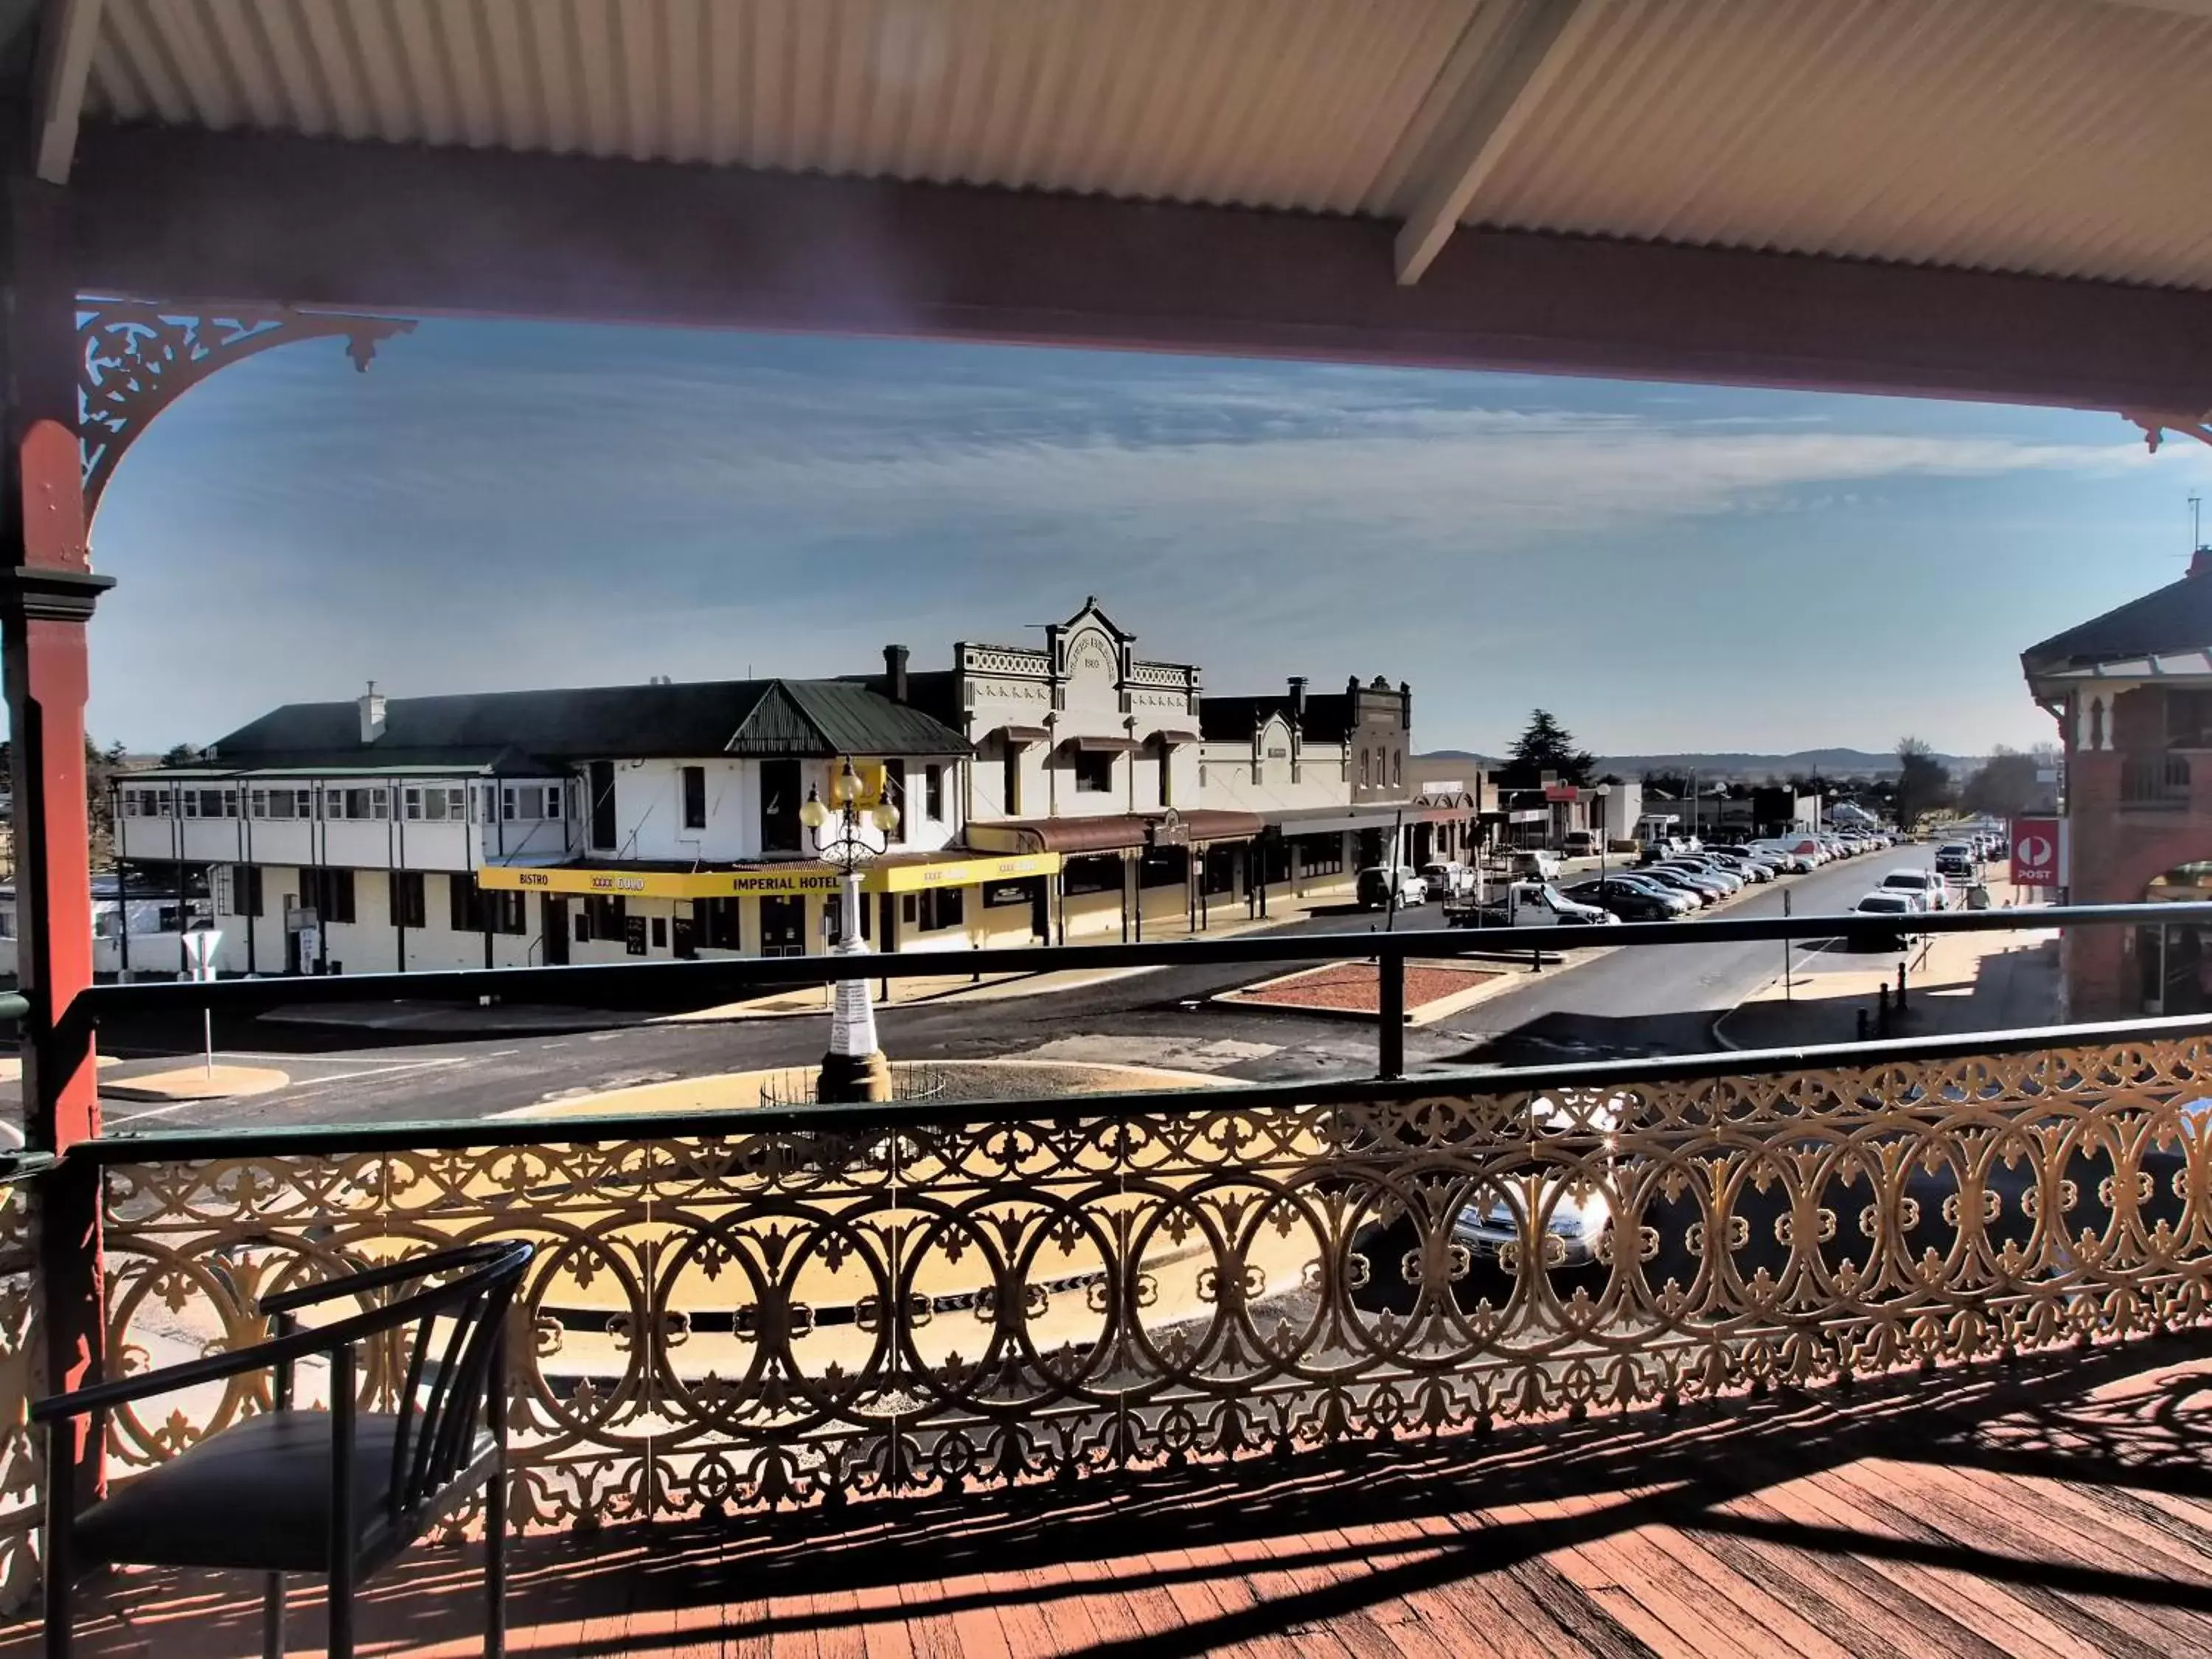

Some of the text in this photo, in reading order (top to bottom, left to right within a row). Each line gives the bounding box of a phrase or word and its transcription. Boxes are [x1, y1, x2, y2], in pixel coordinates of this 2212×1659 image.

[519, 874, 548, 885] BISTRO
[2018, 870, 2051, 879] POST
[734, 876, 841, 891] IMPERIAL HOTEL
